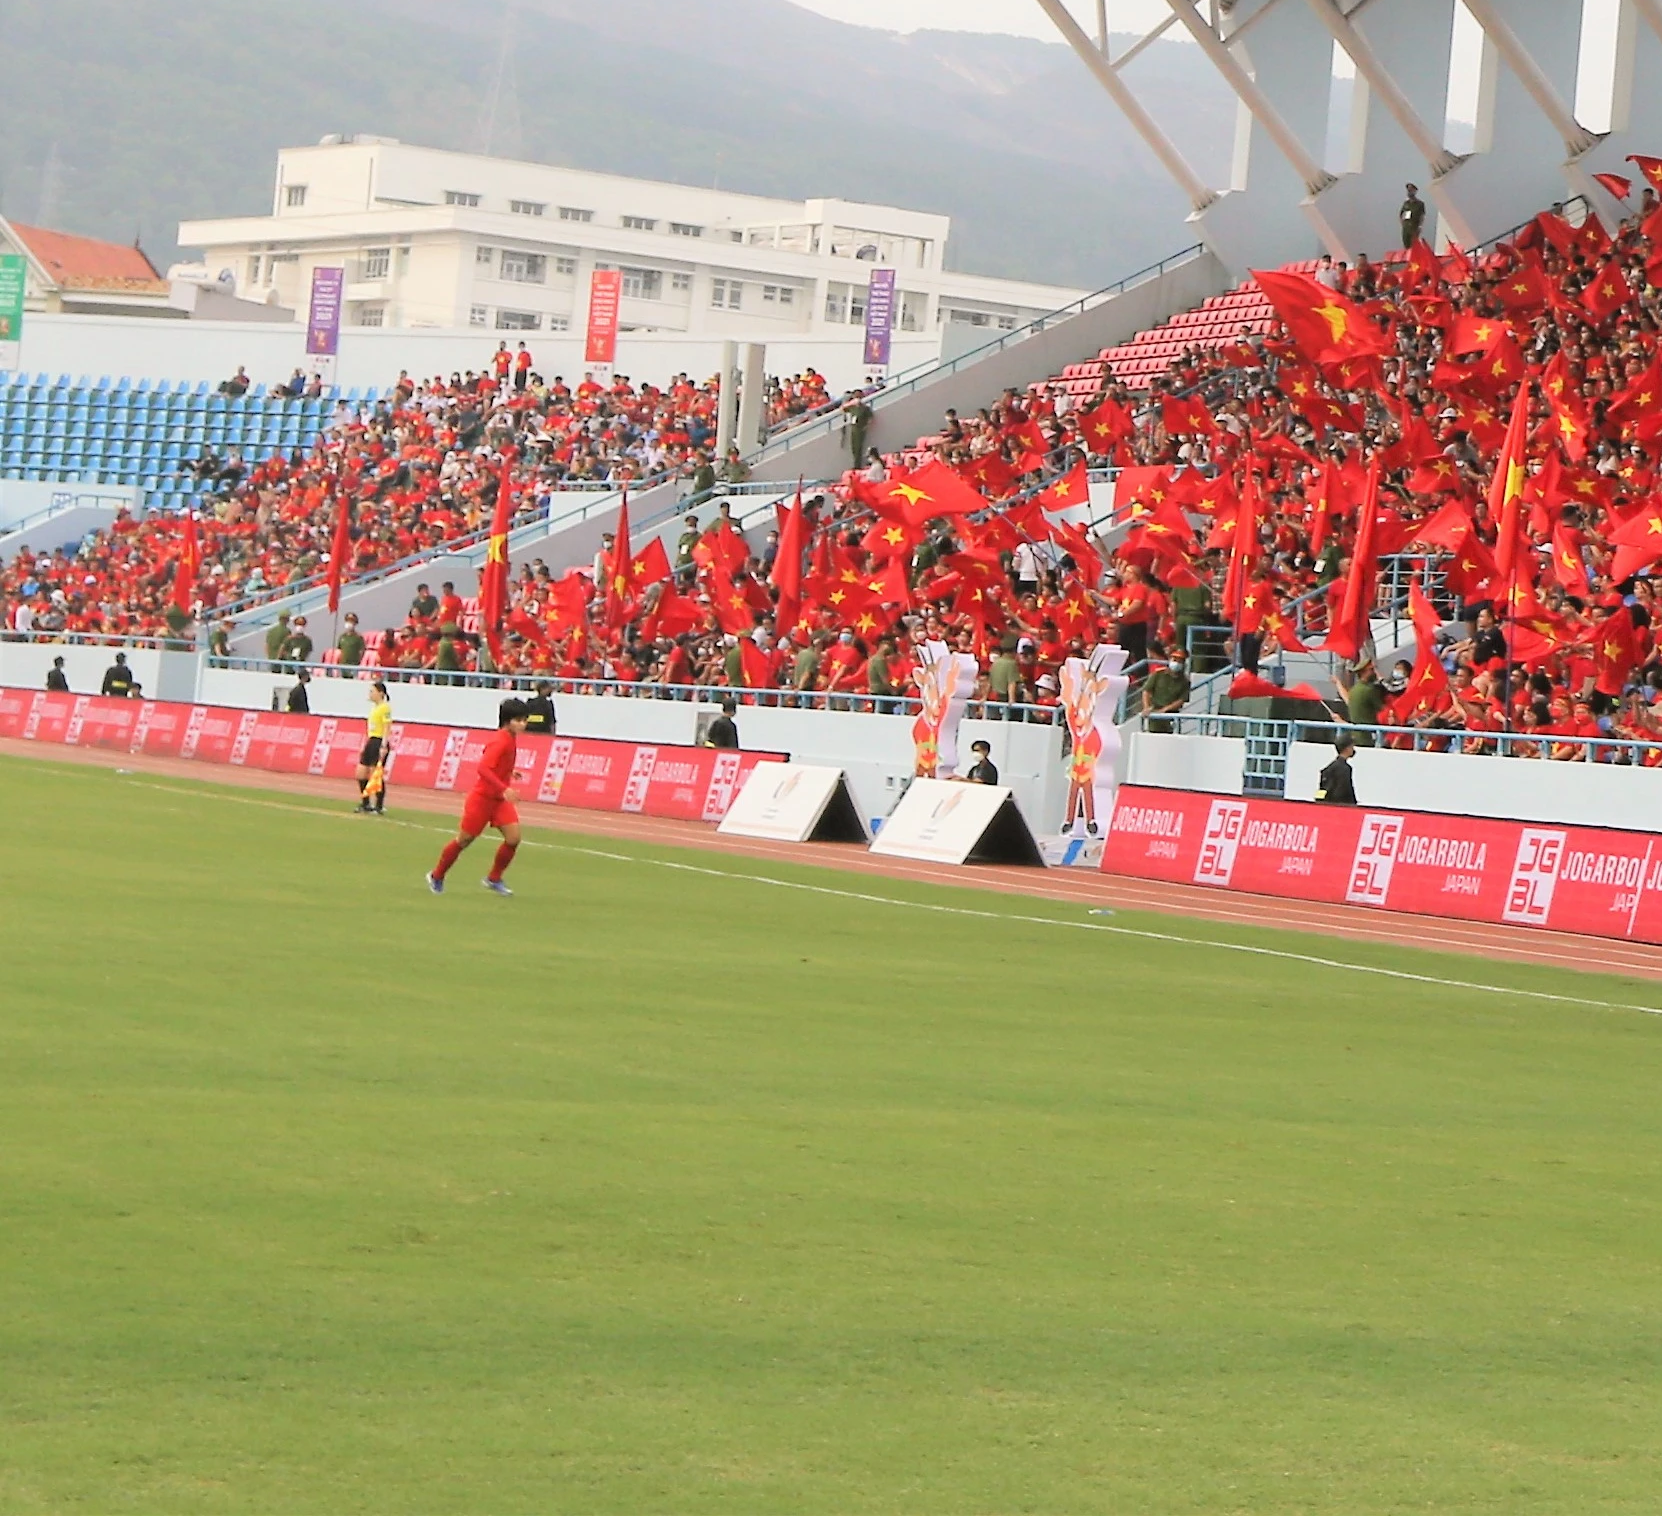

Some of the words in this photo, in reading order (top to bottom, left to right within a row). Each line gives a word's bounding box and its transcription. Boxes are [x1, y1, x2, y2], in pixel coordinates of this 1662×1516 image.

[1110, 804, 1184, 838] JOGARBOLA
[1240, 820, 1319, 853] JOGARBOLA
[1397, 835, 1486, 871] JOGARBOLA
